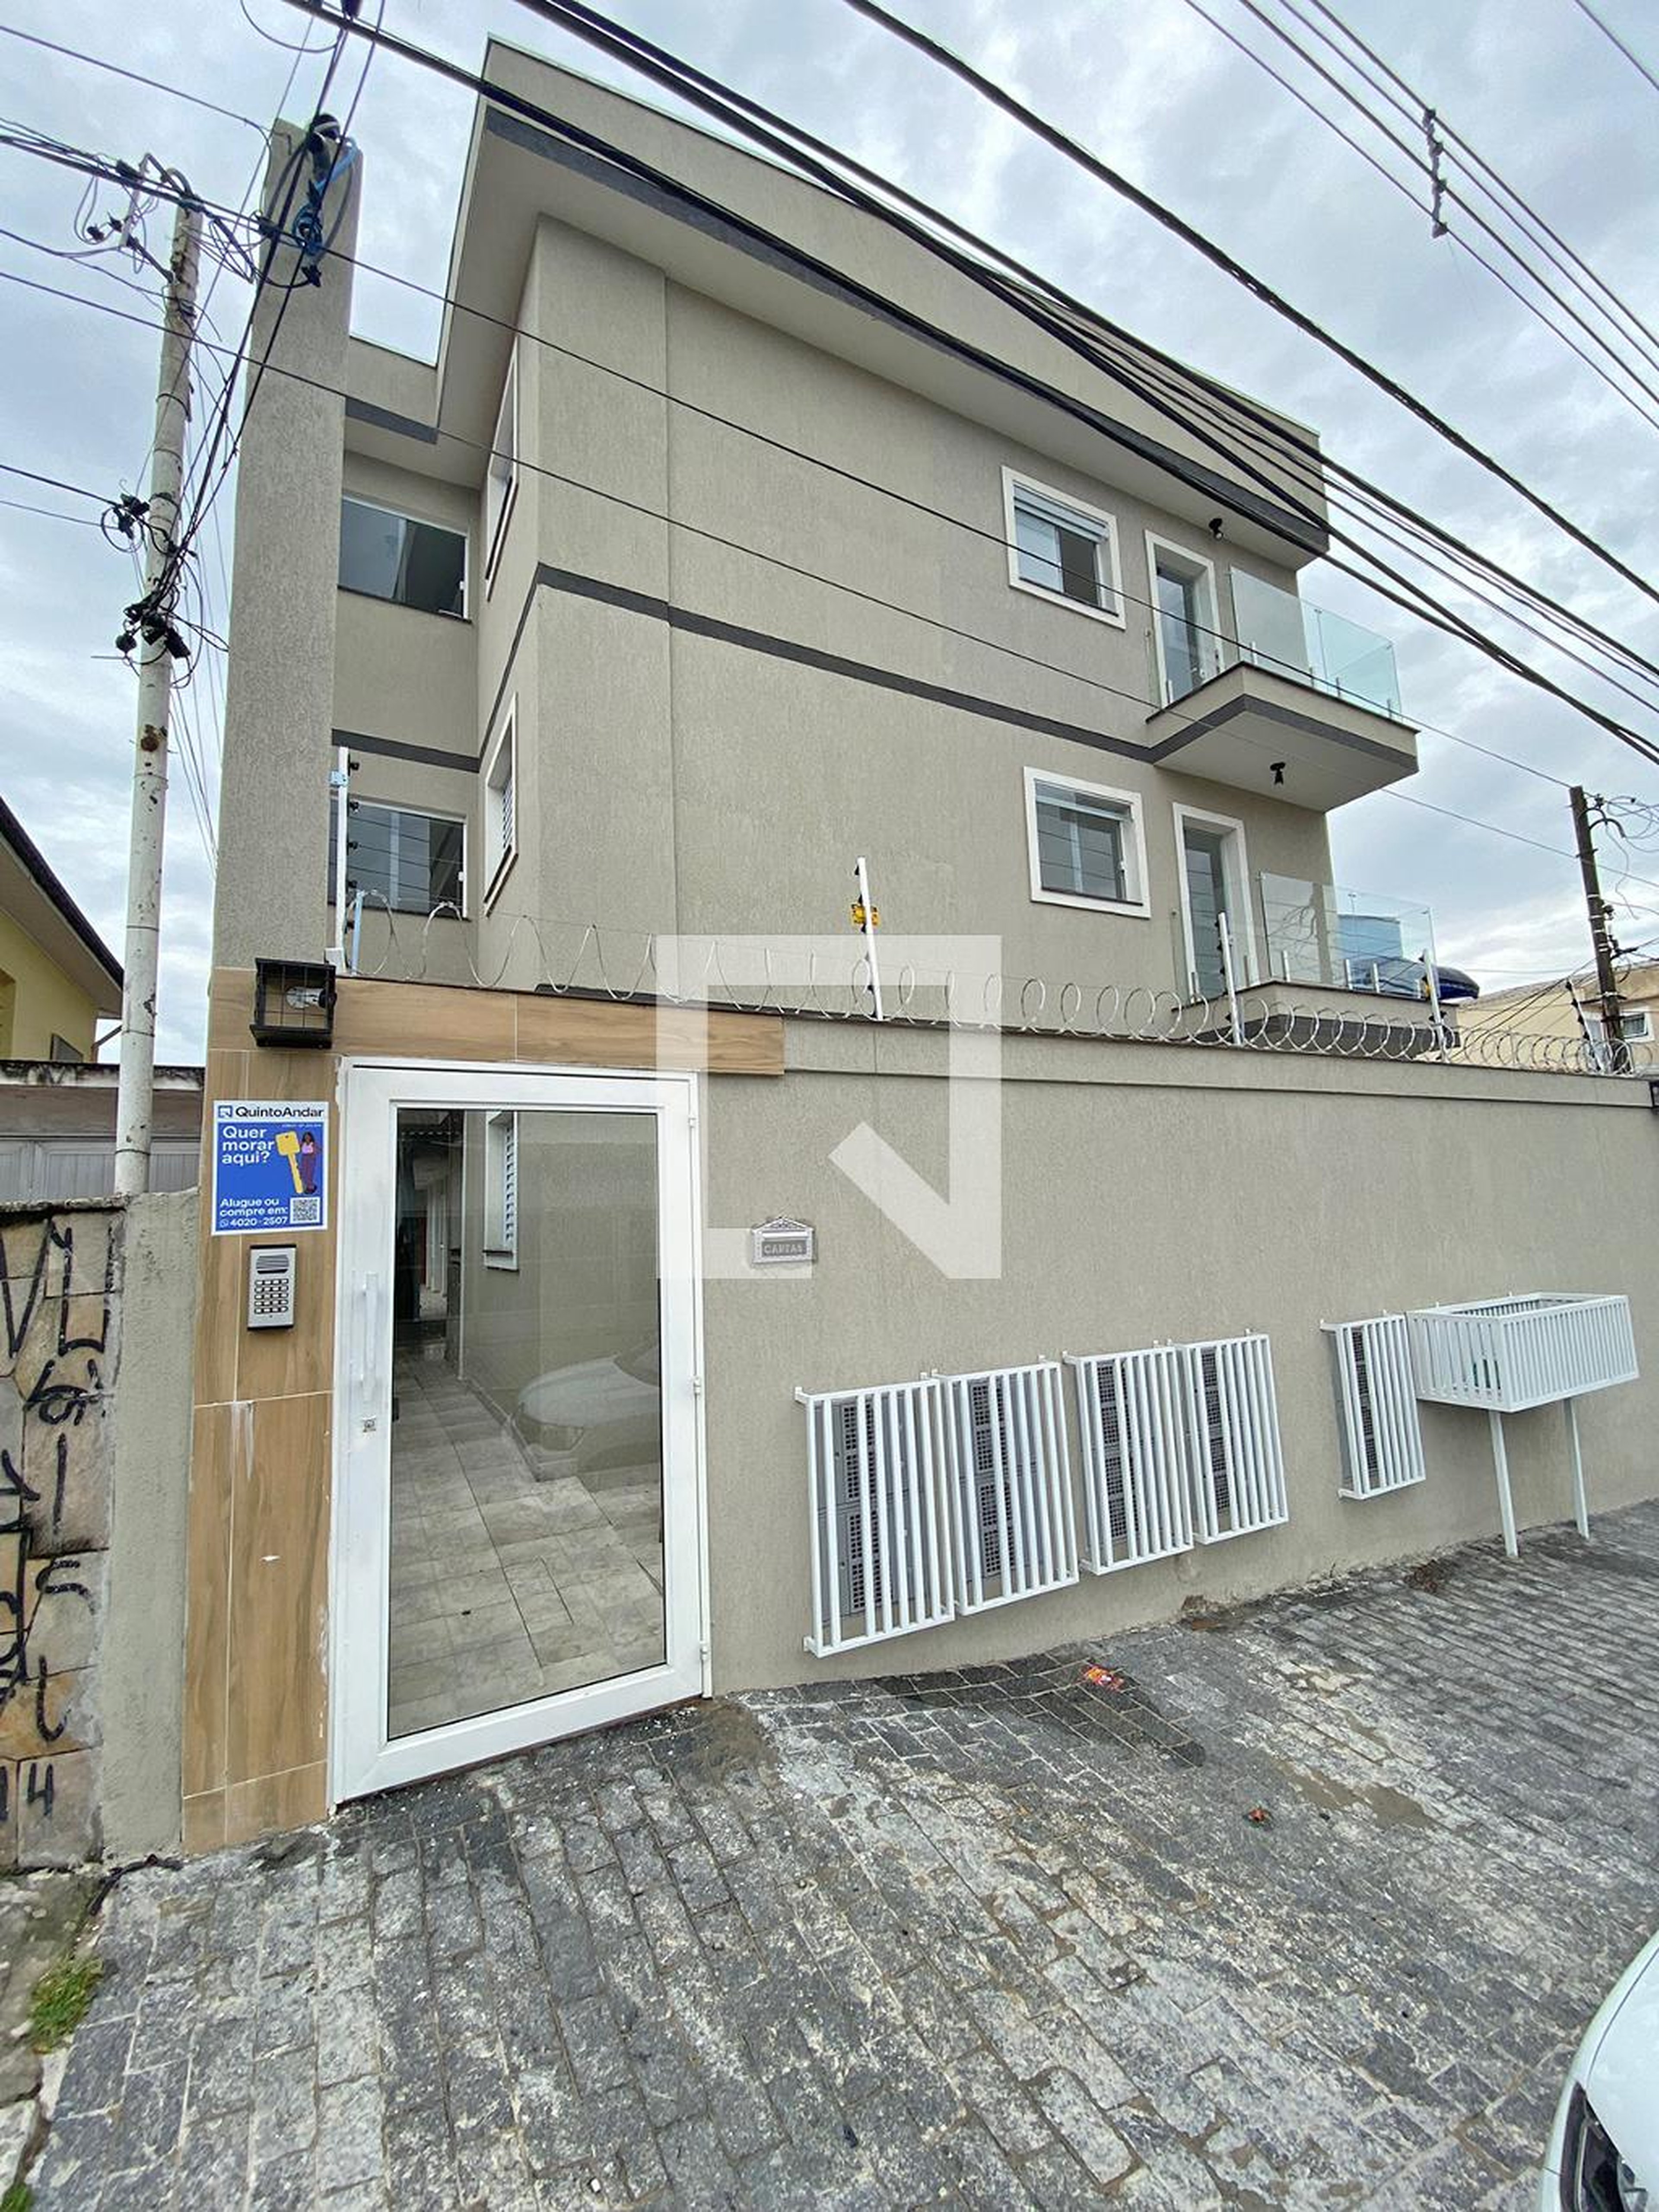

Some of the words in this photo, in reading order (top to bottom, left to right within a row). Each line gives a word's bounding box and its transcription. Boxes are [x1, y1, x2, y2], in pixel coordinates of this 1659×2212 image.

[235, 1107, 324, 1117] QuintoAndar
[223, 1126, 267, 1139] Quer
[222, 1140, 274, 1151] morar
[222, 1151, 270, 1166] aqui?
[220, 1198, 262, 1208] Alugue
[220, 1208, 265, 1217] compre
[267, 1207, 288, 1215] em:
